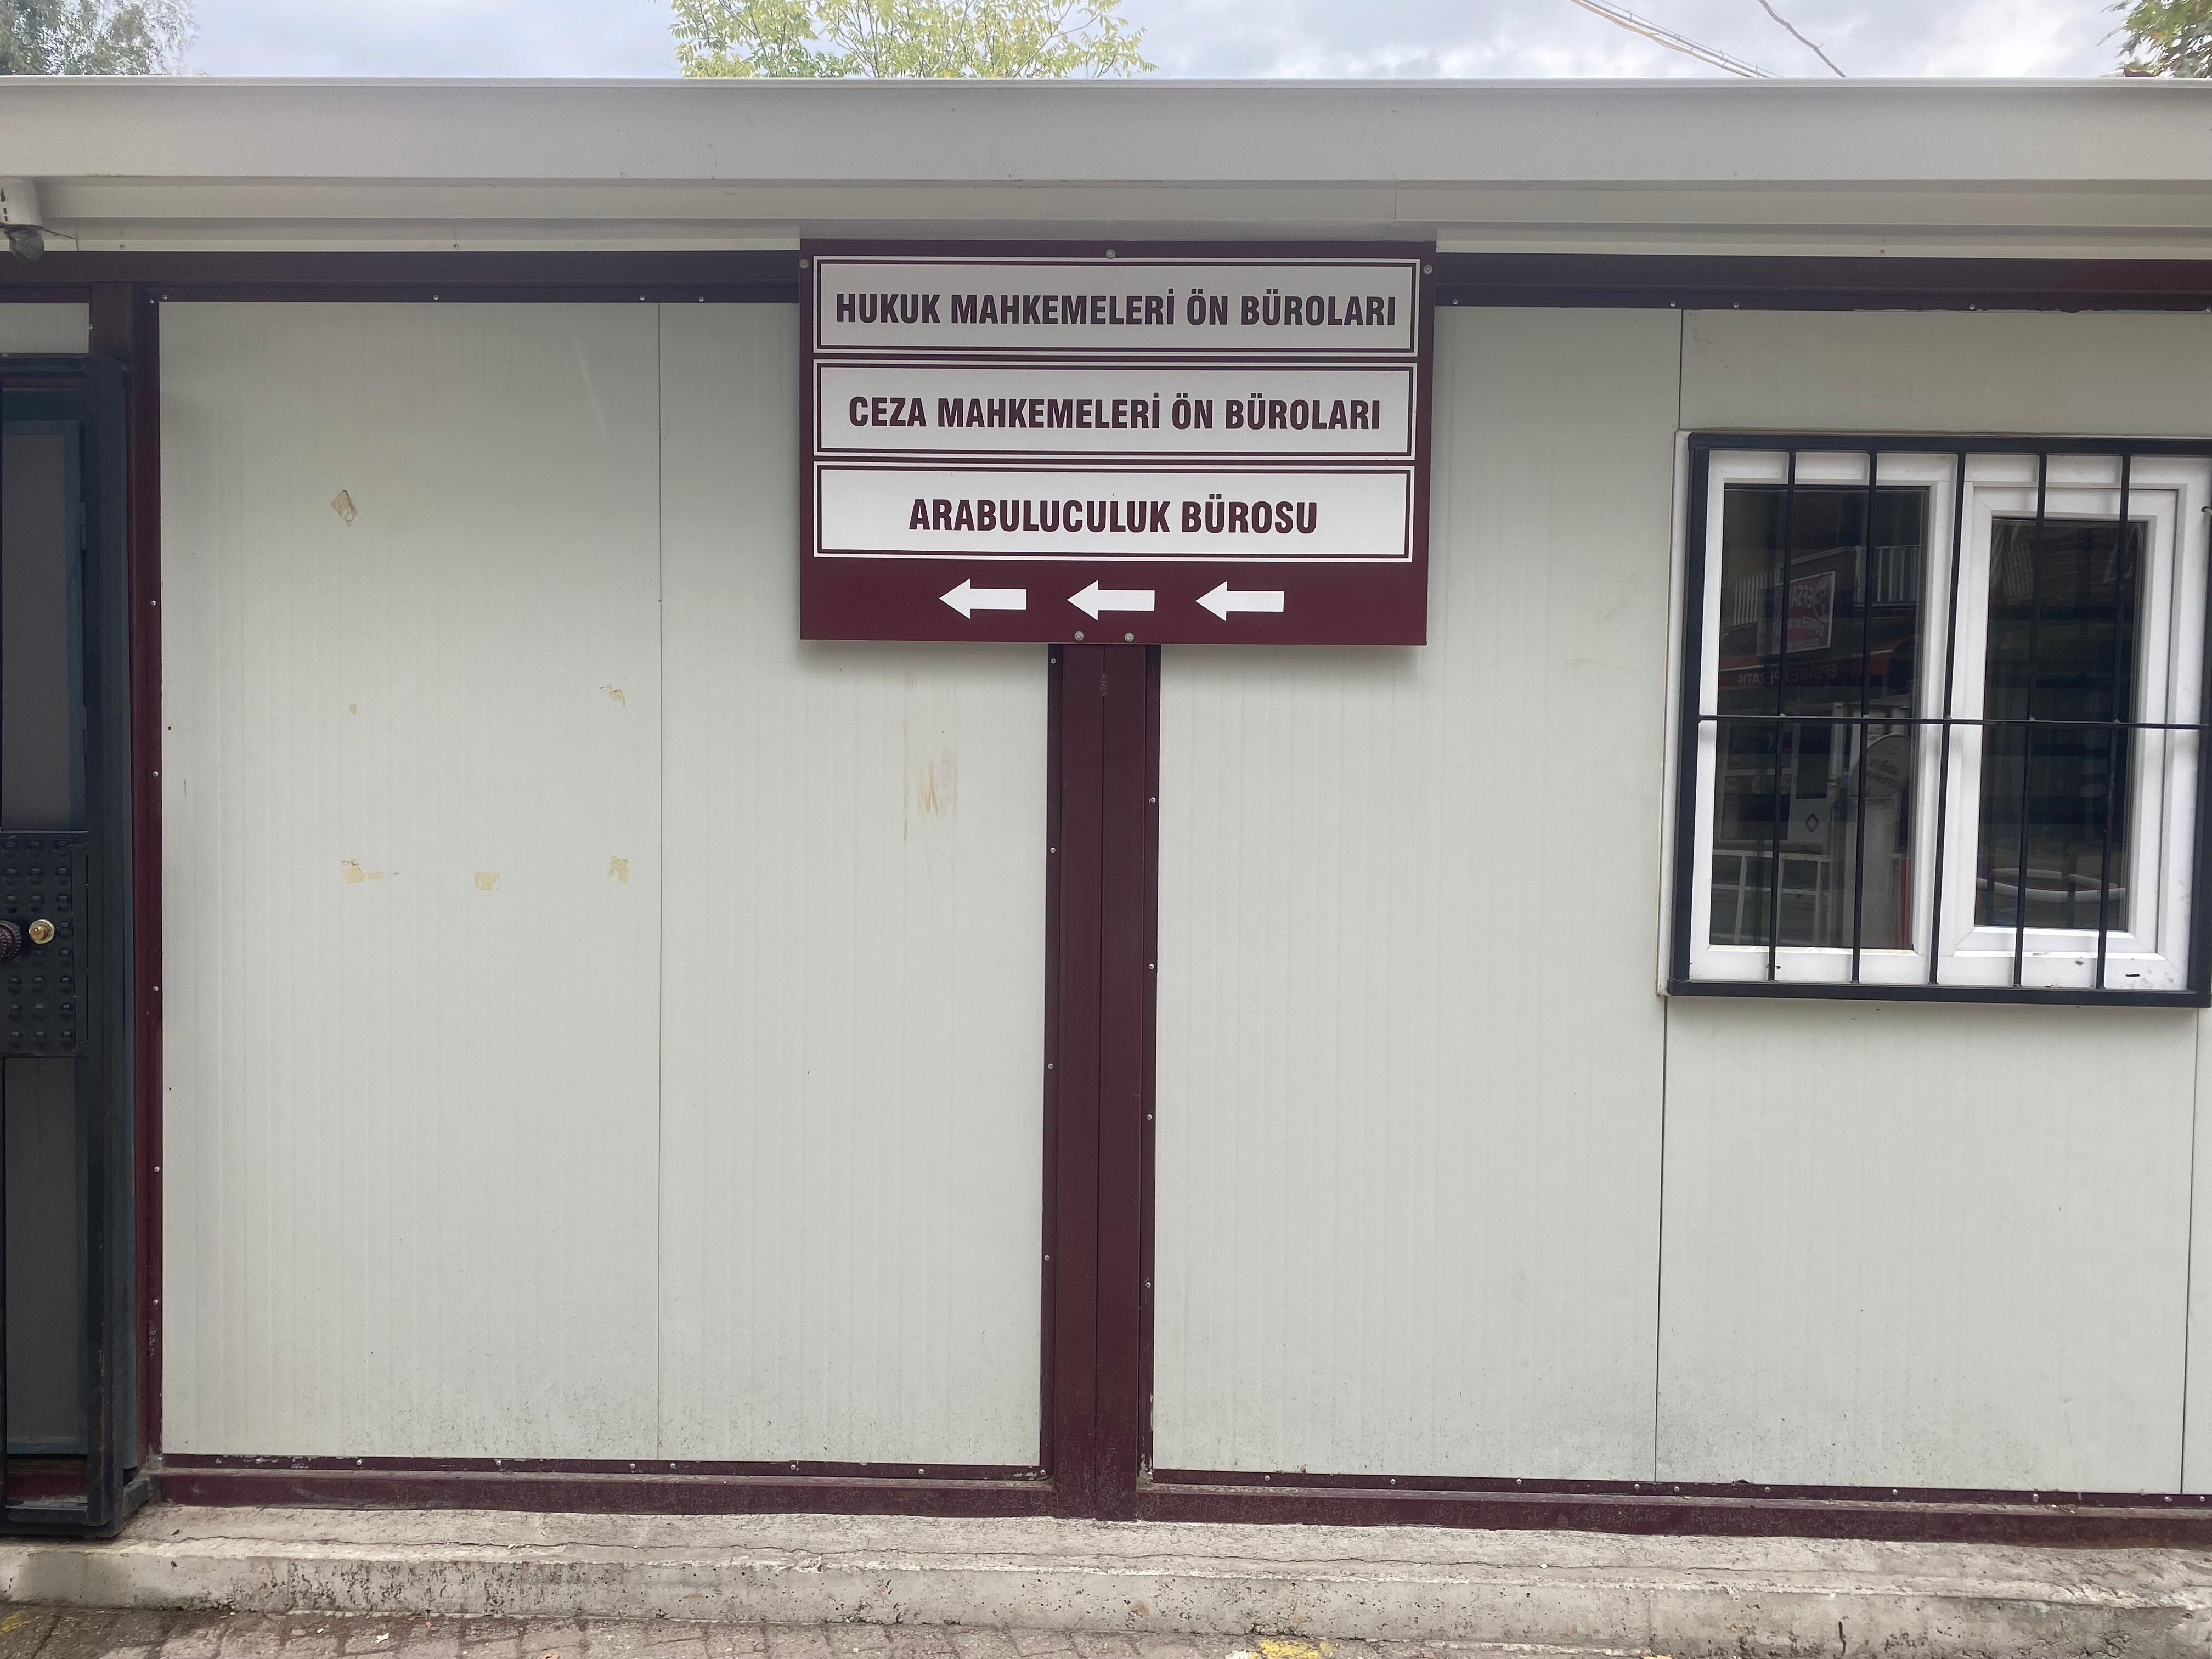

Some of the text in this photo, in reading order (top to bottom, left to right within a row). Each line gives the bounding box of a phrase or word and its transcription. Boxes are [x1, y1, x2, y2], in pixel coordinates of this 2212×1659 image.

[836, 288, 1396, 326] HUKUK MAHKEMELERİ ÖN BÜROLARI
[849, 392, 1380, 430] CEZA MAHKEMELERİ ÖN BÜROLARI
[909, 493, 1317, 534] ARABULUCULUK BÜROSU
